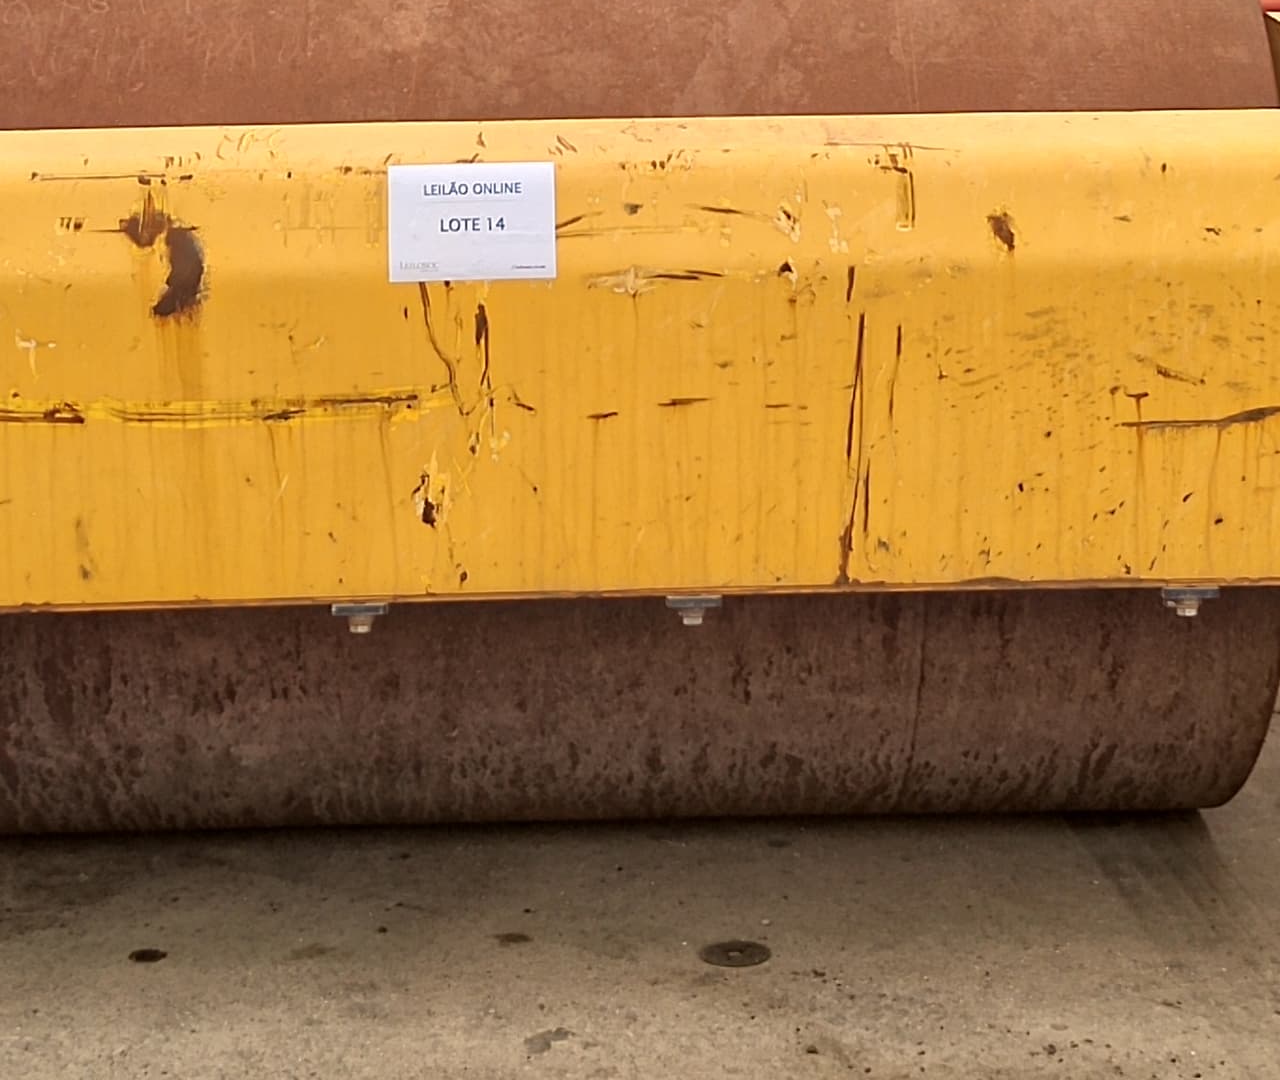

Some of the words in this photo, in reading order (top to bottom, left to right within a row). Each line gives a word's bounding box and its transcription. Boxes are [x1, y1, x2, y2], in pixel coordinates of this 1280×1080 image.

[423, 181, 469, 197] LEILÃO
[472, 182, 522, 195] ONLINE
[439, 218, 481, 233] LOTE
[486, 217, 506, 231] 14
